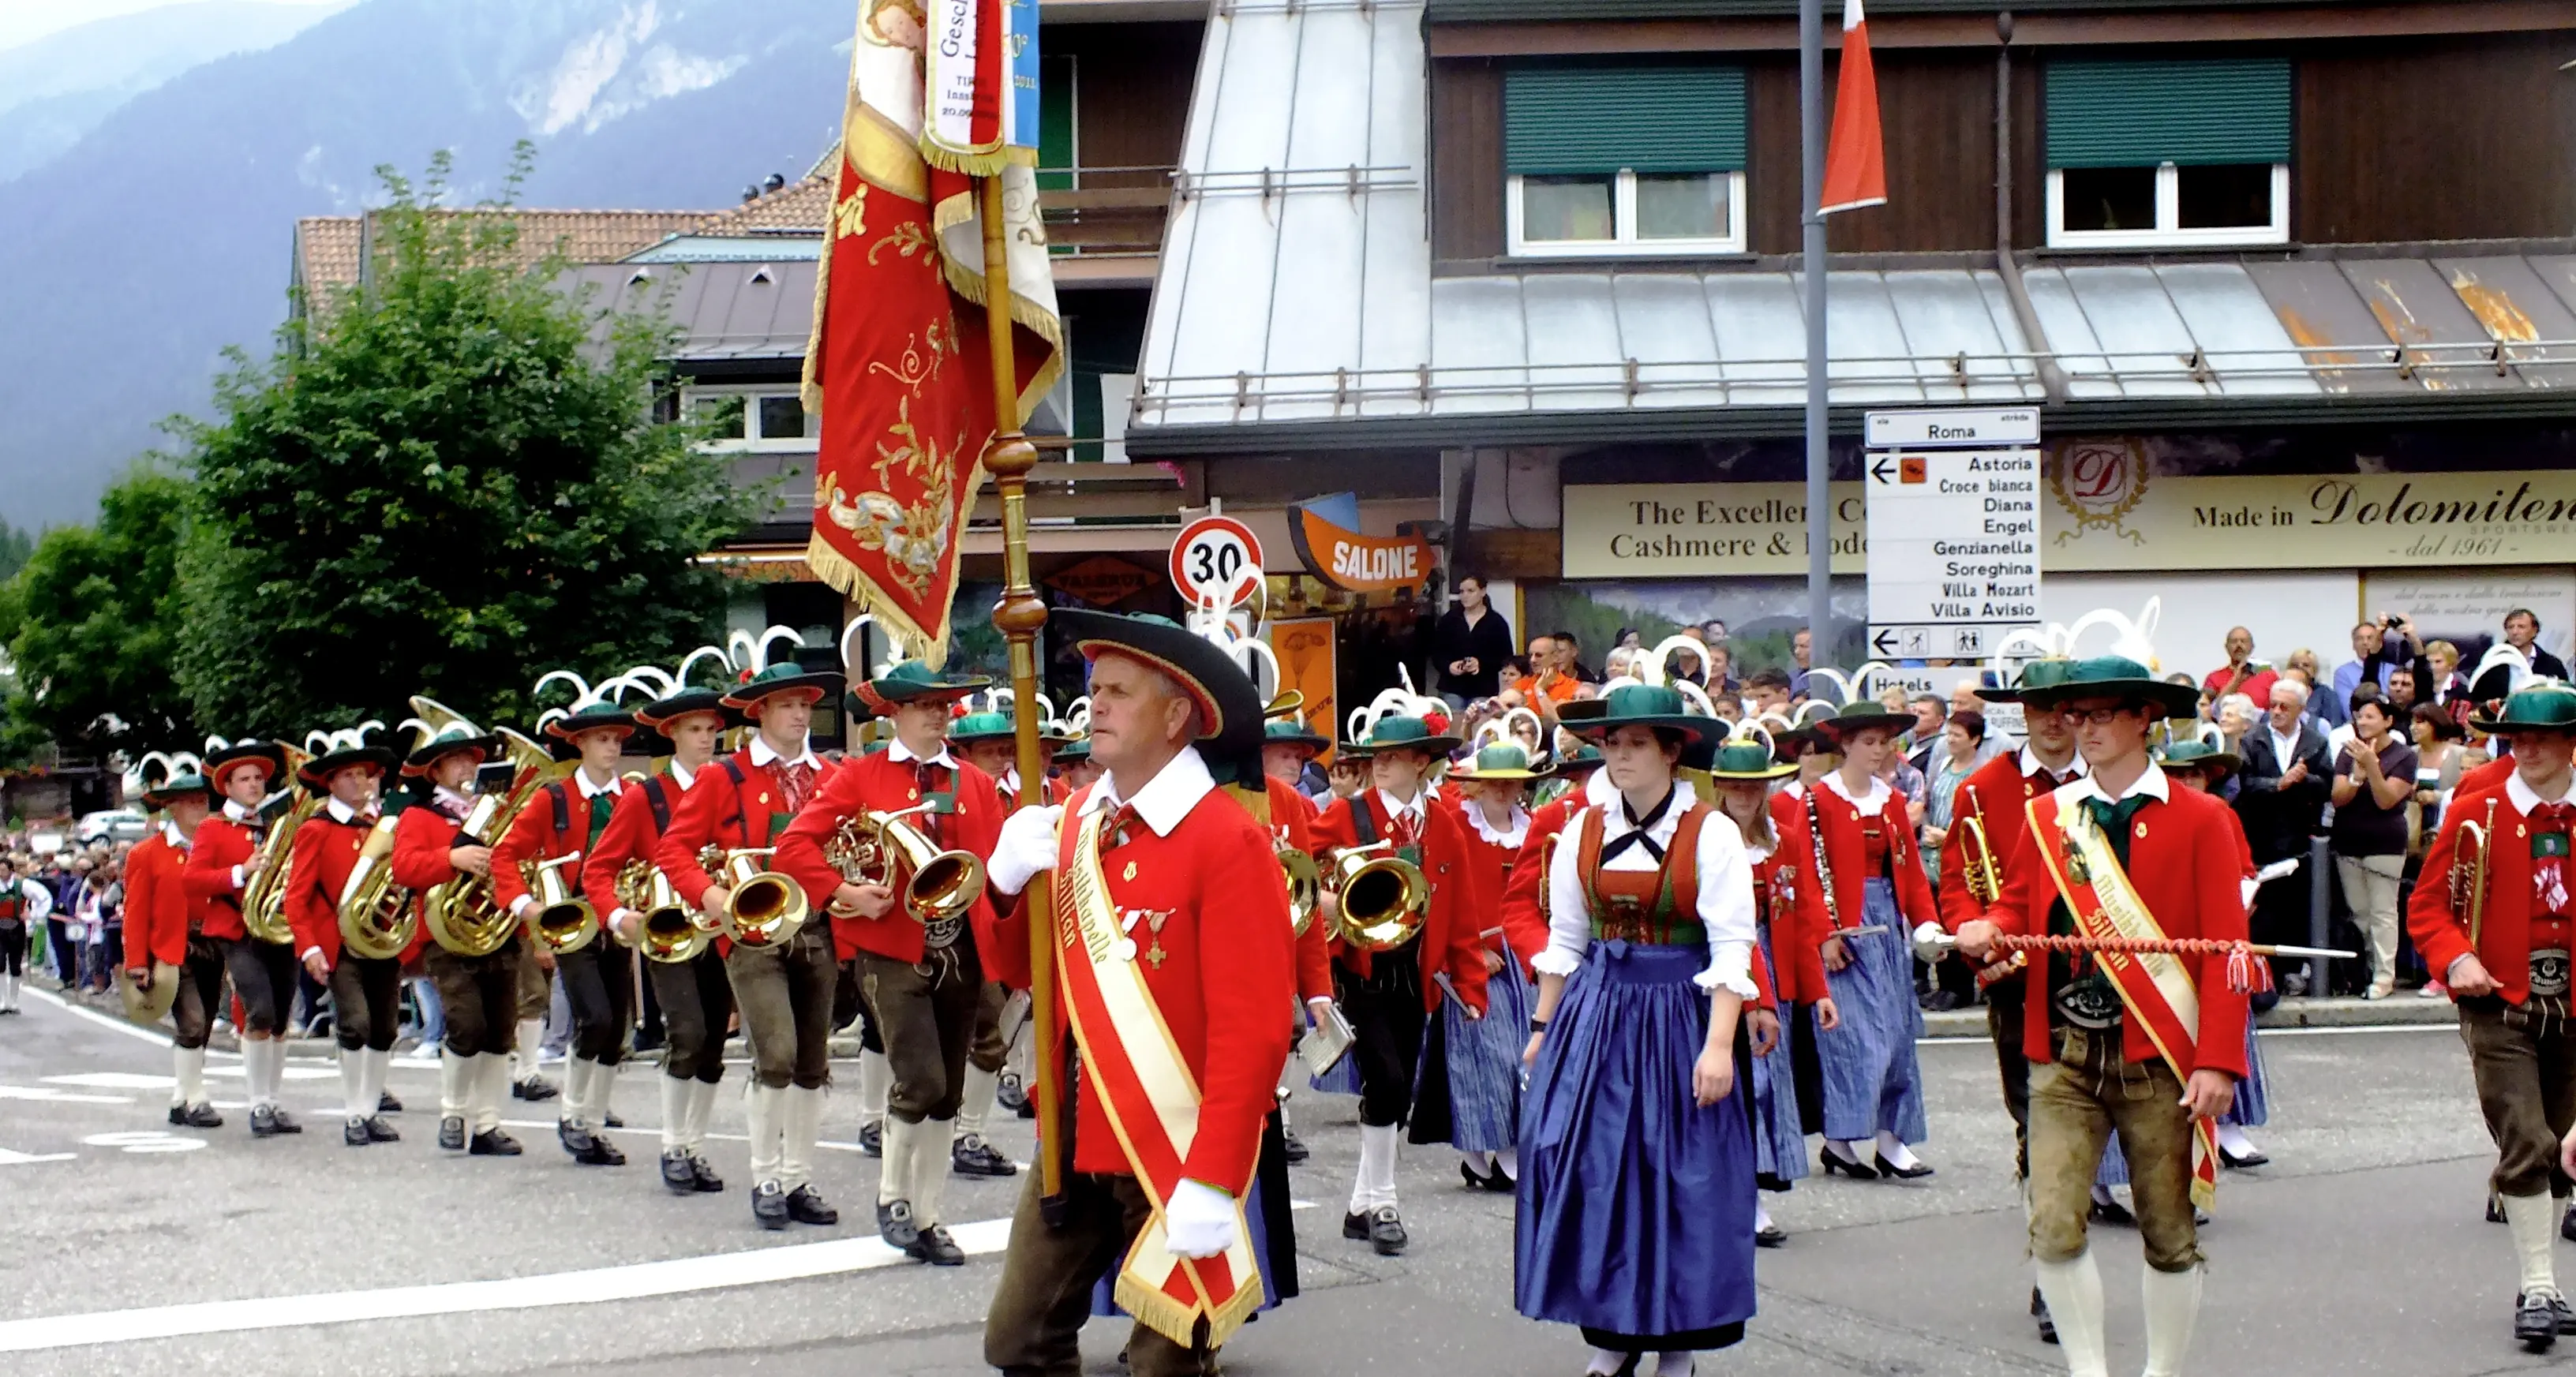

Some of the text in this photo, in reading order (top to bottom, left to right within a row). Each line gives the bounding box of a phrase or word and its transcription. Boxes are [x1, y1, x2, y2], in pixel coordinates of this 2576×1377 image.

[1928, 425, 1976, 439] Roma
[1969, 457, 2032, 471] Astoria
[1939, 478, 2033, 493] Croce bianca
[1630, 500, 1684, 525] The
[1984, 498, 2032, 513] Diana
[2193, 506, 2262, 528] Made
[2272, 506, 2293, 526] in
[1984, 518, 2034, 536] Engel
[2470, 524, 2576, 536] SPORTSWE
[1610, 533, 1756, 559] Cashmere
[1766, 531, 1791, 556] &
[1934, 541, 2033, 556] Genzianella
[2405, 534, 2448, 557] dal
[2451, 537, 2503, 556] 1961
[1191, 542, 1241, 583] 30
[1333, 541, 1419, 581] SALONE
[1946, 561, 2033, 579] Soreghina
[1942, 582, 2035, 597] Villa Mozart
[1931, 602, 2035, 618] Villa Avisio
